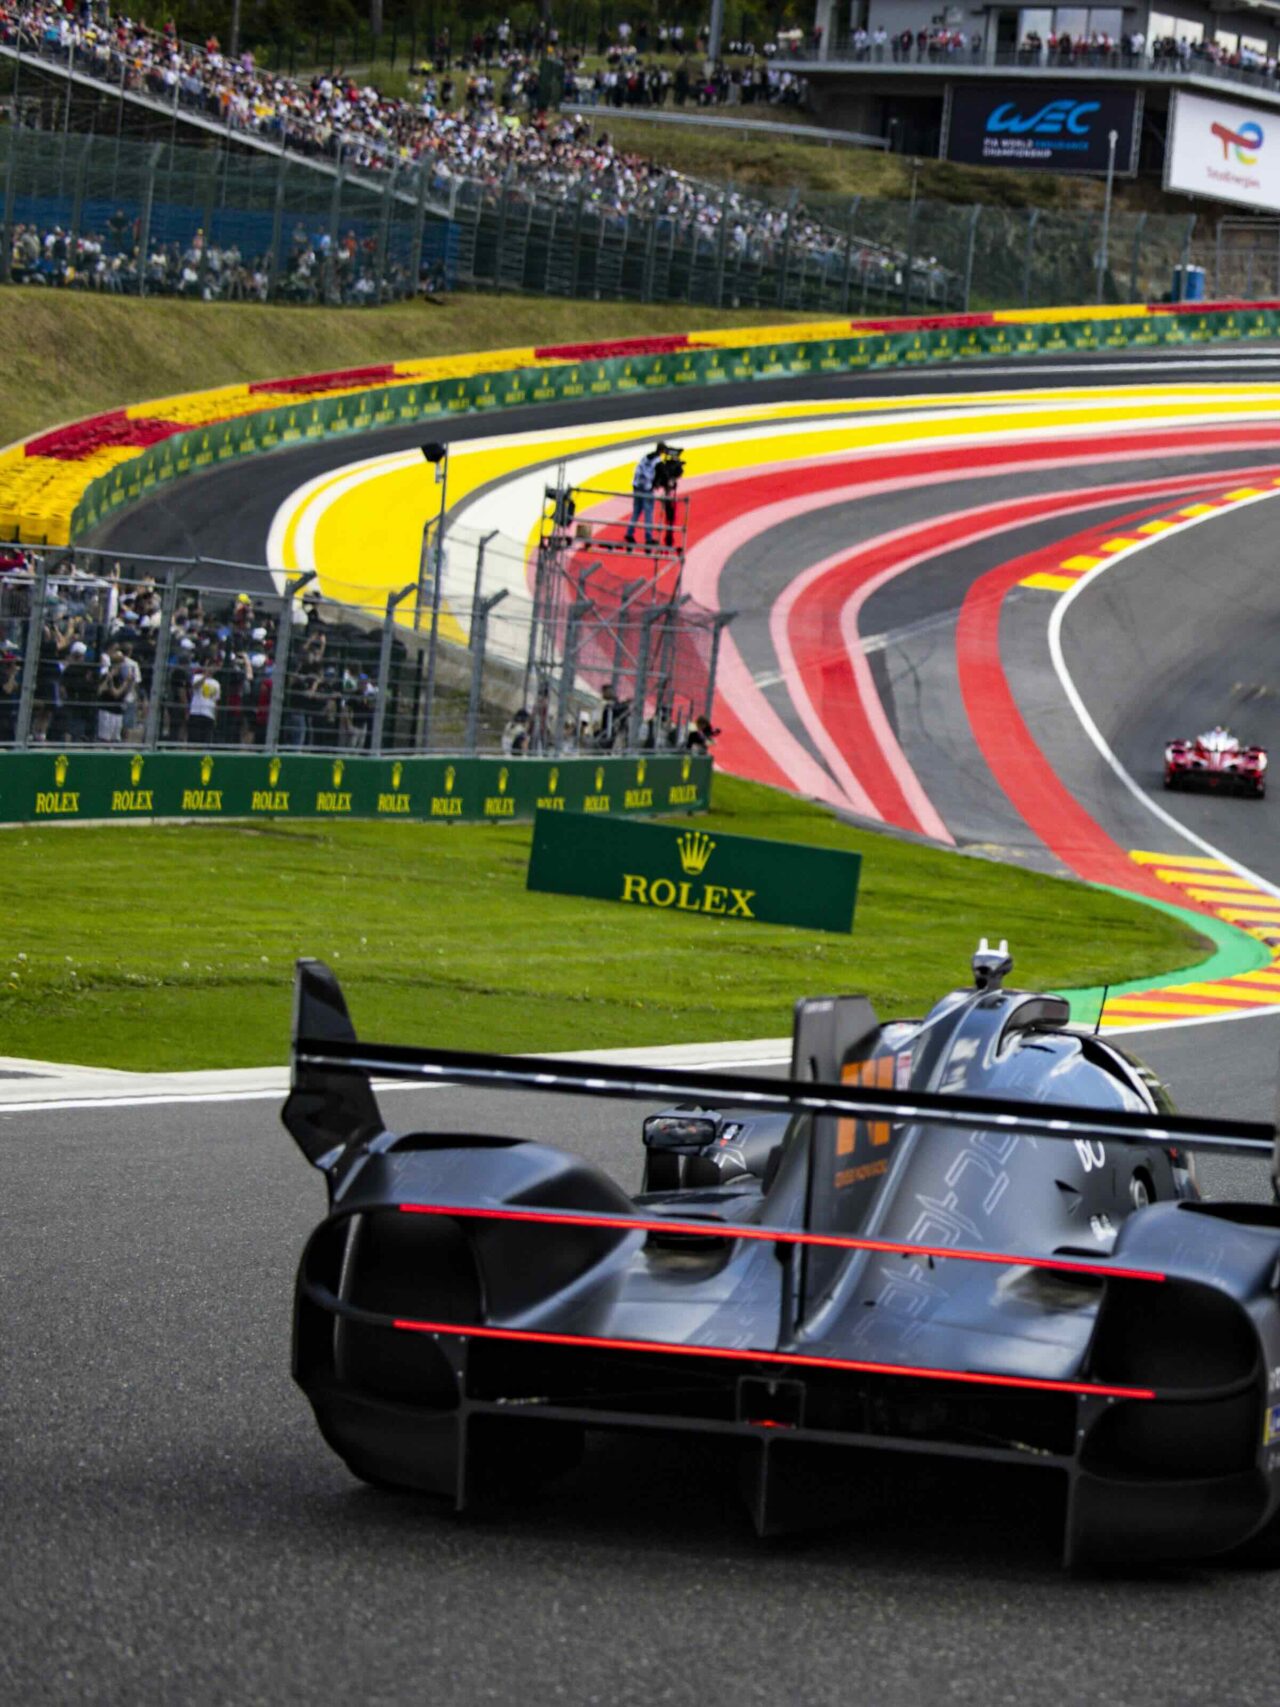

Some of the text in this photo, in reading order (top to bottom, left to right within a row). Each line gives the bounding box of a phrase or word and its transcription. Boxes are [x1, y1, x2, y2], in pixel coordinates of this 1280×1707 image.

[986, 99, 1101, 134] WEC
[35, 791, 80, 813] ROLEX
[112, 790, 154, 811] ROLEX
[182, 789, 223, 810] ROLEX
[252, 791, 290, 811] ROLEX
[316, 792, 353, 812] ROLEX
[377, 793, 412, 813] ROLEX
[624, 788, 654, 808] ROLEX
[668, 784, 699, 805] ROLEX
[431, 797, 463, 816] ROLEX
[484, 797, 516, 816] ROLEX
[620, 873, 757, 918] ROLEX
